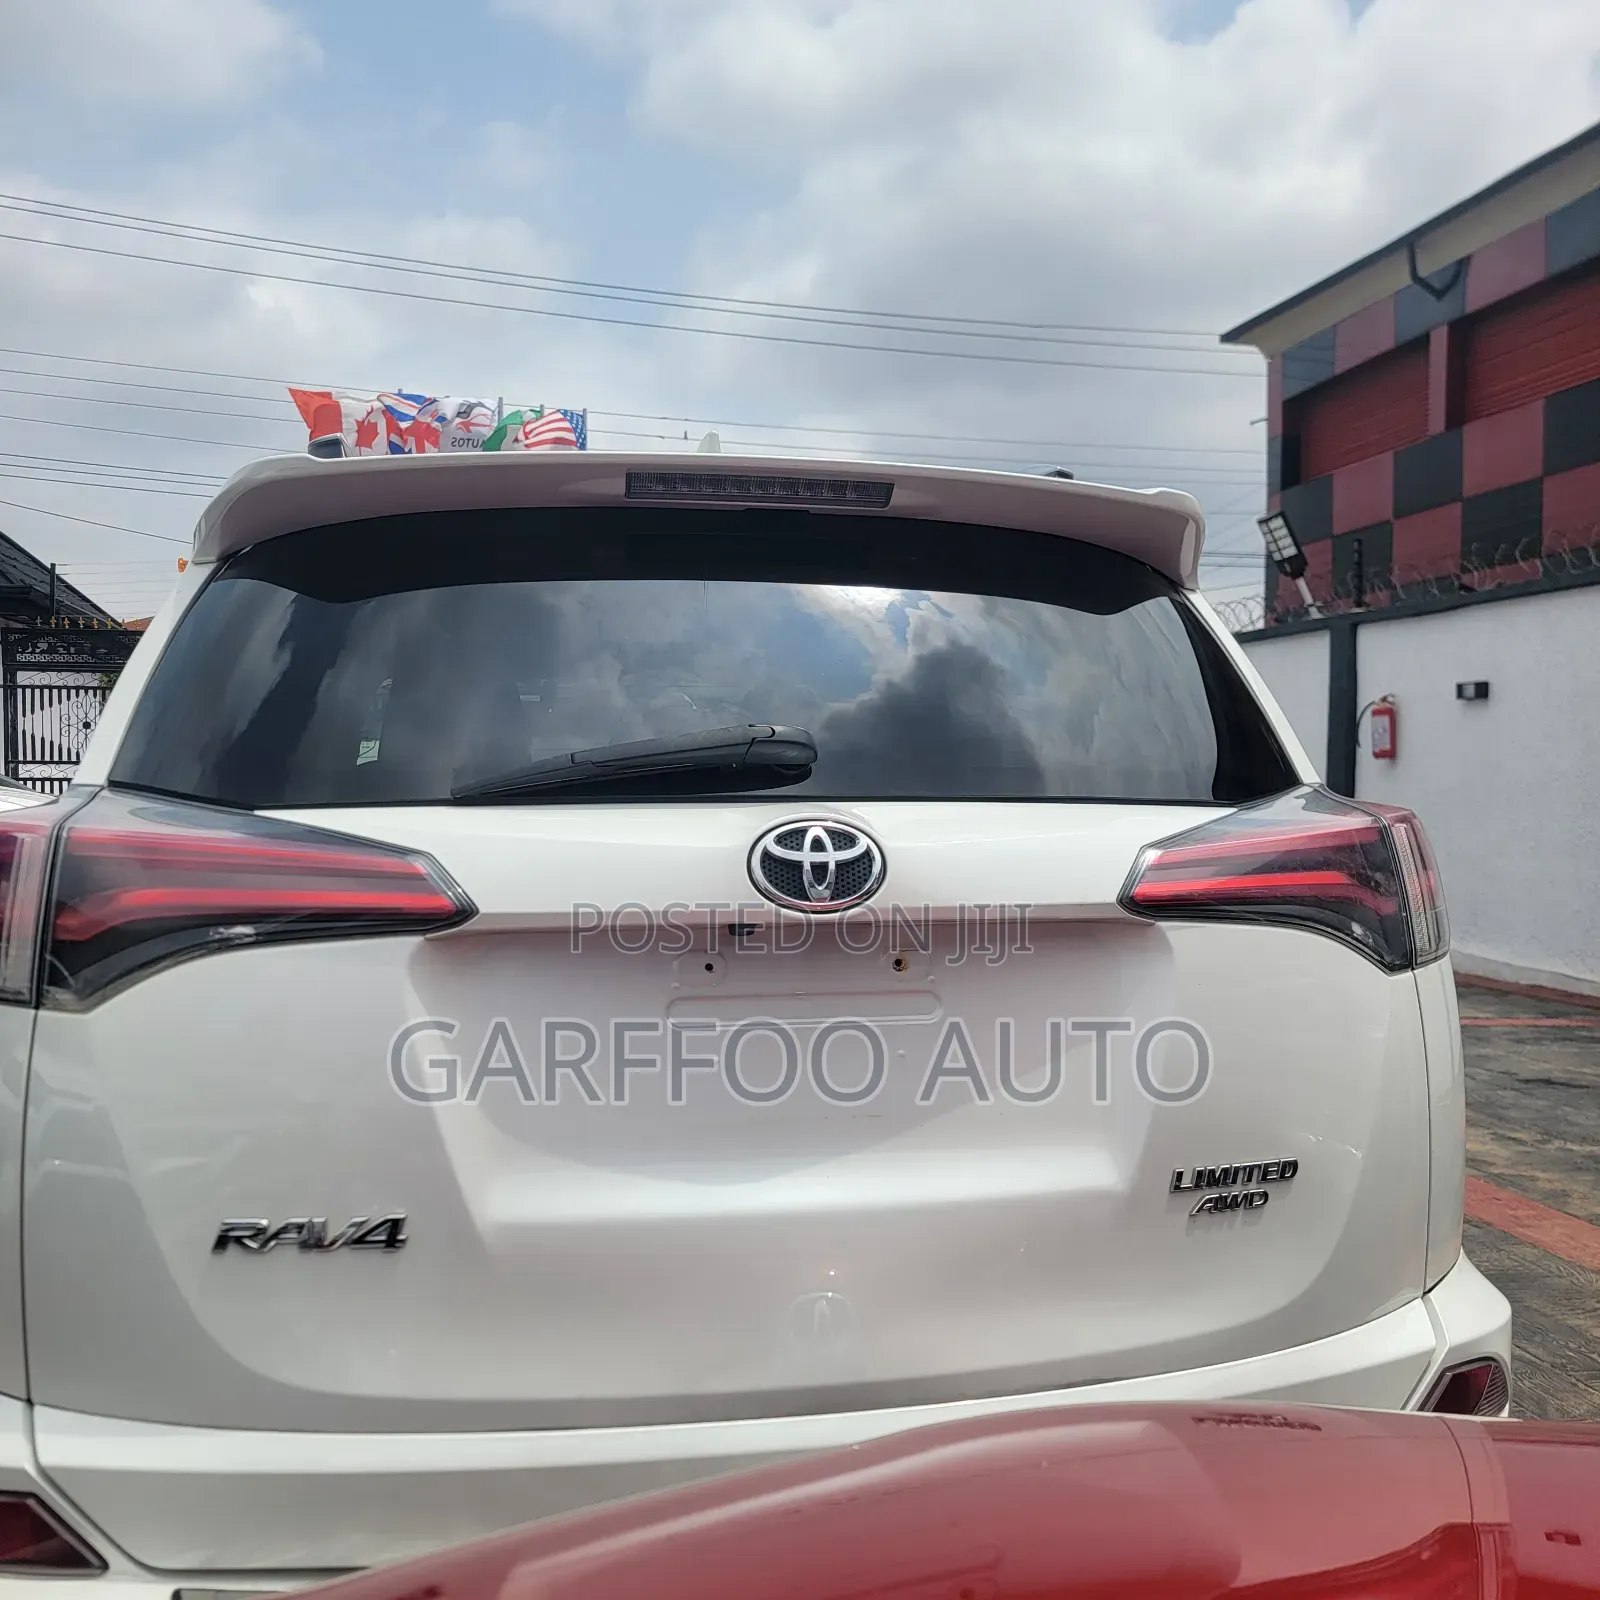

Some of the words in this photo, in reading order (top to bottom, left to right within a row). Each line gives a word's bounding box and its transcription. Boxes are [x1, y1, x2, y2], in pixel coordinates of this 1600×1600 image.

[1169, 1157, 1299, 1193] LIMITED
[1189, 1188, 1269, 1216] AWD
[211, 1212, 408, 1254] RAV4
